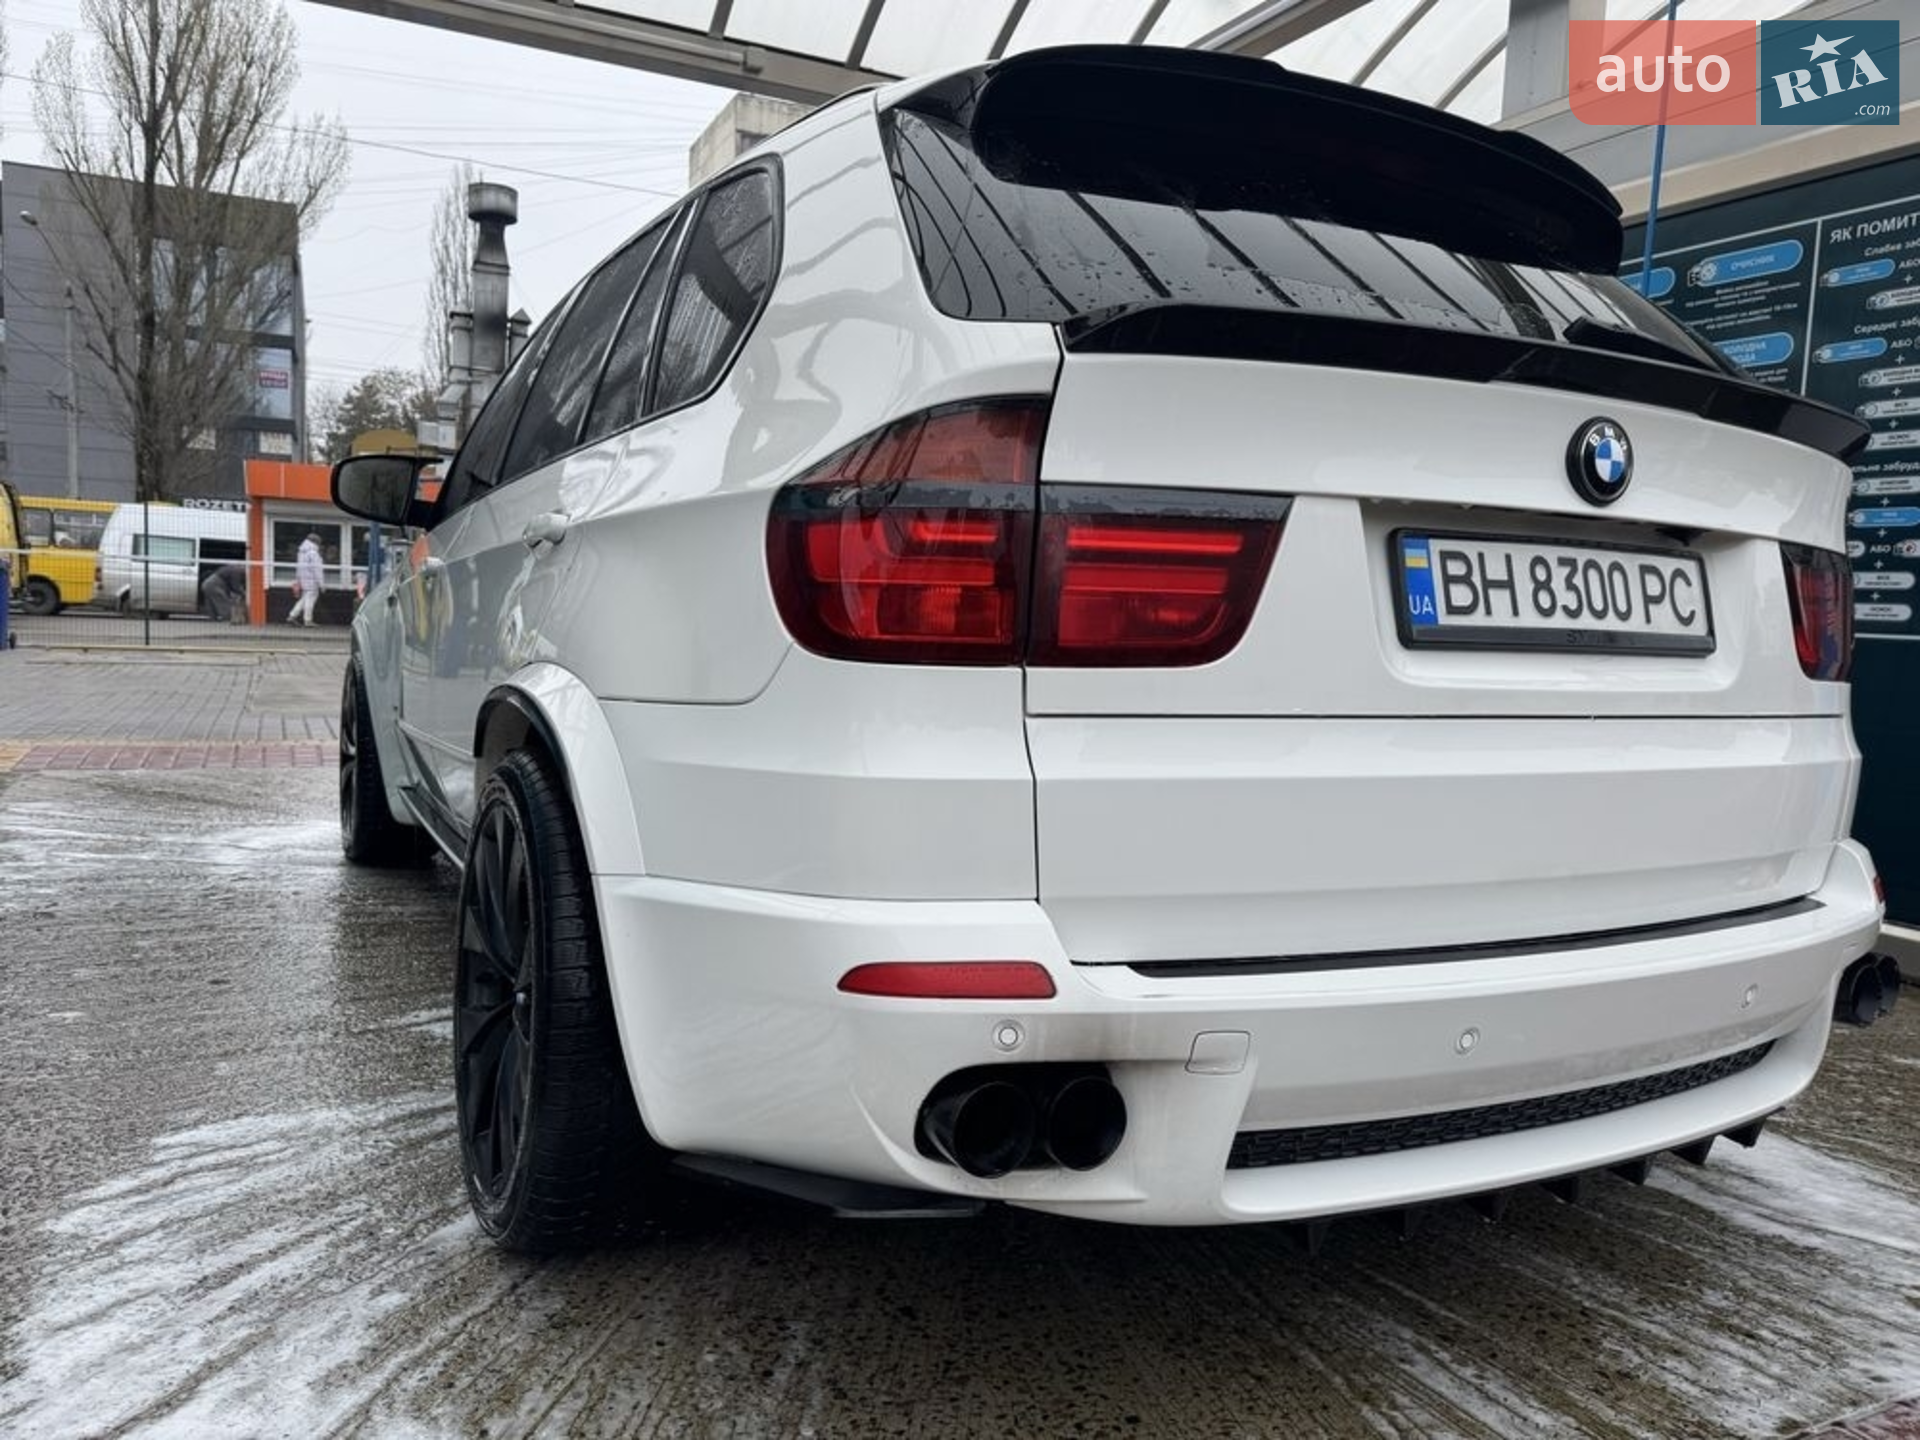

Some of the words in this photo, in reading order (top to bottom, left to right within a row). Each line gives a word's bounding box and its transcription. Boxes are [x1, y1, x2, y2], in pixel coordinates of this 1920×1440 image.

[1829, 226, 1853, 244] ЯК
[1438, 549, 1519, 617] BH
[1529, 555, 1632, 622] 8300
[1638, 563, 1696, 626] PC
[1409, 594, 1434, 615] UA
